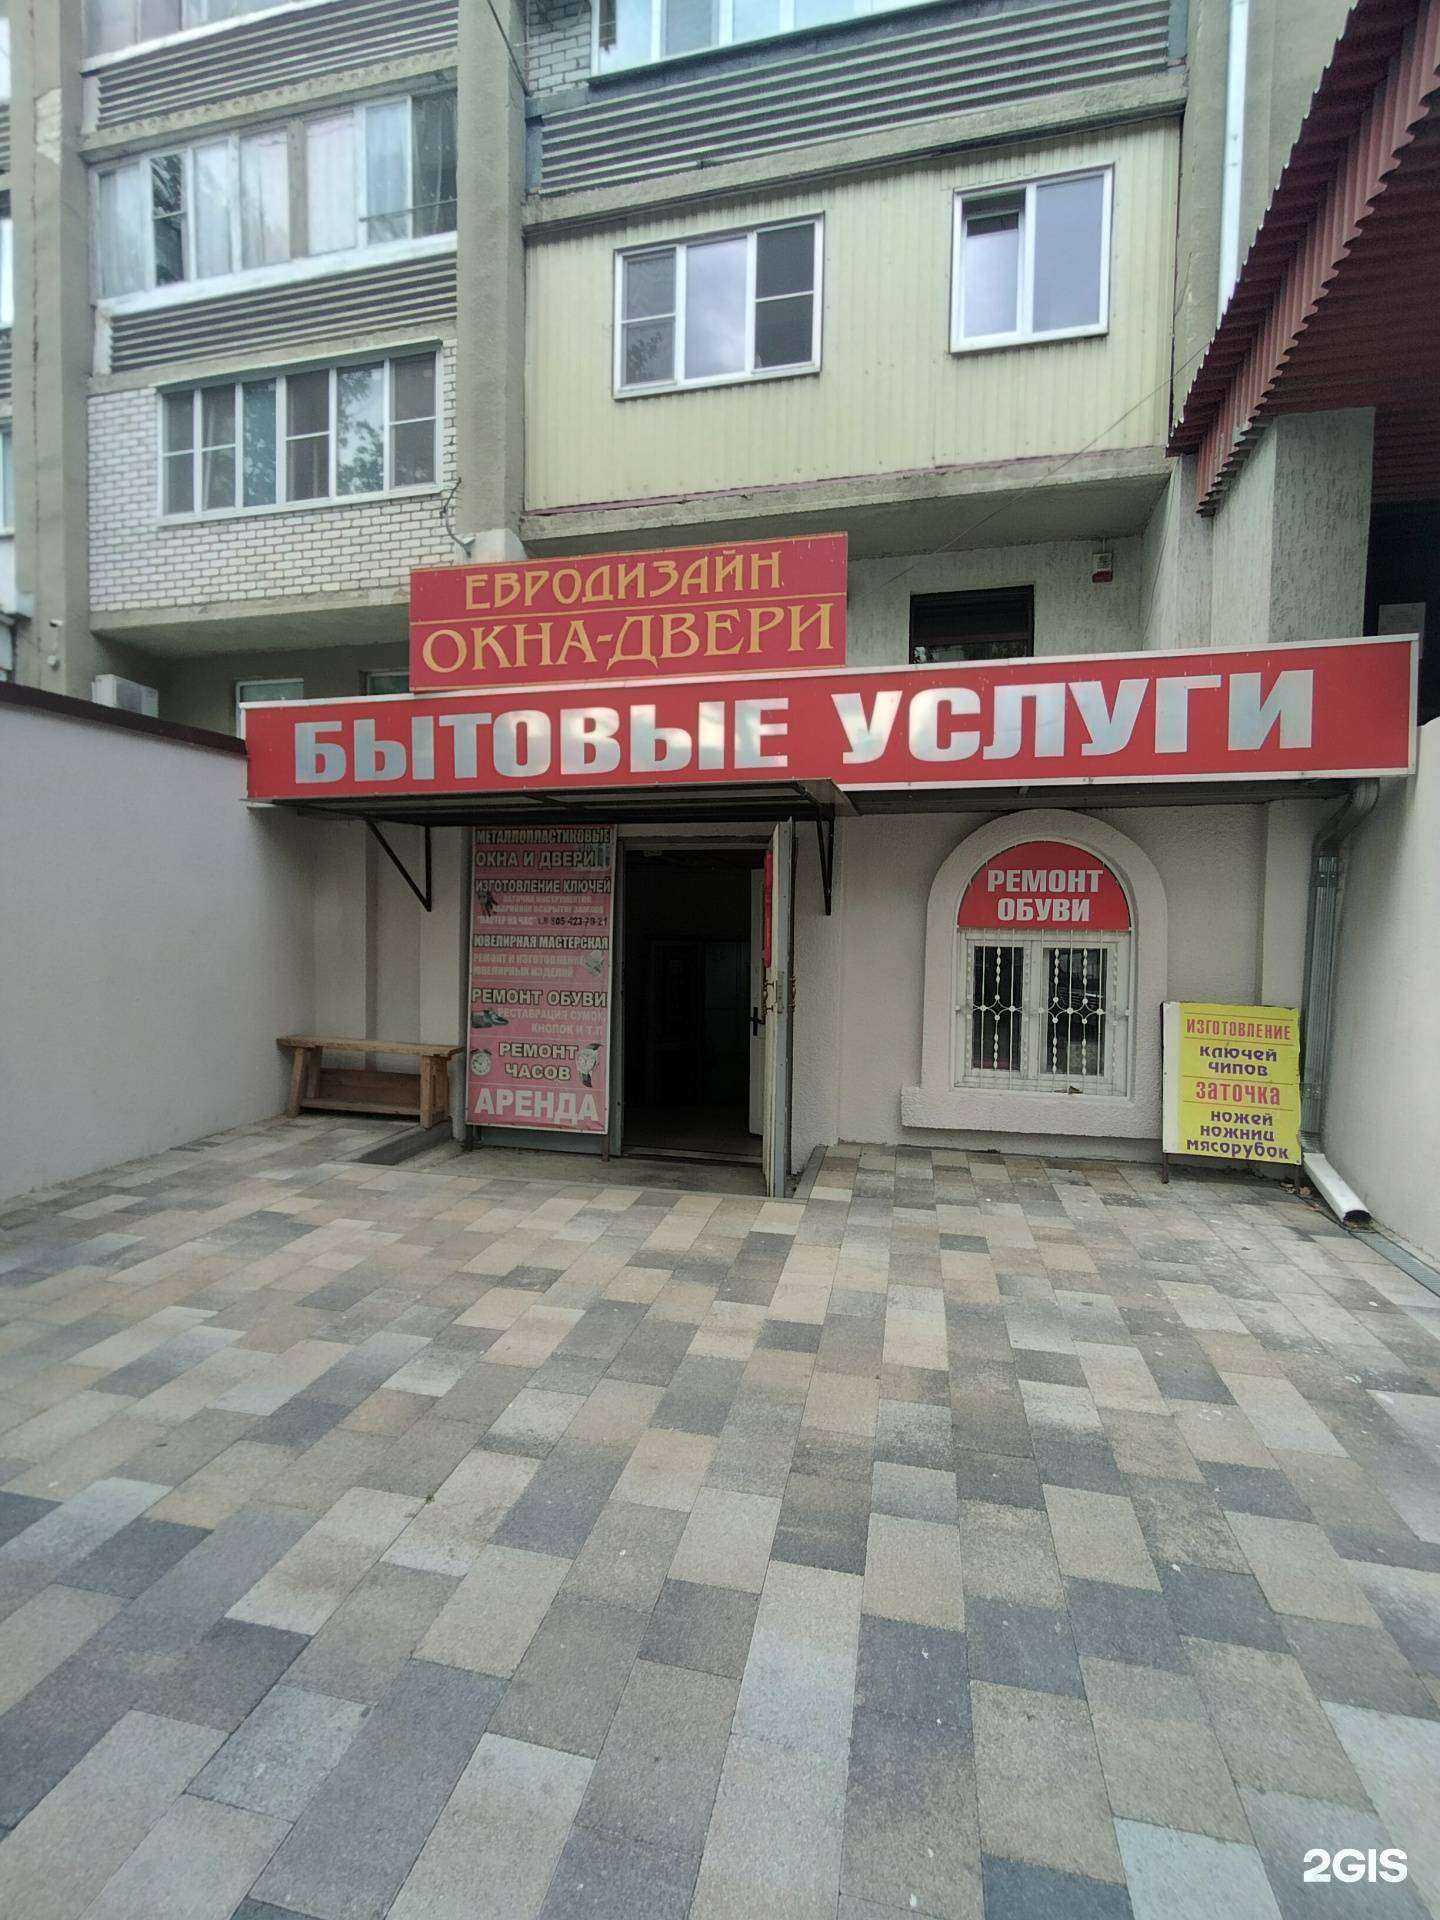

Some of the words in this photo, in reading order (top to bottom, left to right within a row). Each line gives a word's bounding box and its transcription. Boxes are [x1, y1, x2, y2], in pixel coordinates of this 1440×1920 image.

[465, 550, 783, 610] ЕВРОДИЗАЙН
[422, 603, 835, 673] ОКНА-ДВЕРИ
[294, 697, 789, 785] БЫТОВЫЕ
[831, 669, 1314, 765] УСЛУГИ
[476, 851, 518, 867] ОКНА
[539, 851, 595, 869] ДВЕРИ
[475, 879, 560, 893] ИЗГОТОВЛЕНИЕ
[563, 877, 612, 893] КЛЮЧЕЙ
[987, 870, 1104, 893] РЕМОНТ
[997, 898, 1090, 922] ОБУВИ
[473, 934, 537, 948] ЮВЕЛИРНАЯ
[539, 936, 609, 949] МАСТЕРСКАЯ
[471, 987, 543, 1005] РЕМОНТ
[547, 991, 609, 1007] ОБУВИ
[1186, 1018, 1292, 1040] ИЗГОТОВЛЕНИЕ
[498, 1042, 579, 1060] РЕМОНТ
[505, 1063, 571, 1080] ЧАСОВ
[474, 1087, 600, 1125] АРЕНДА
